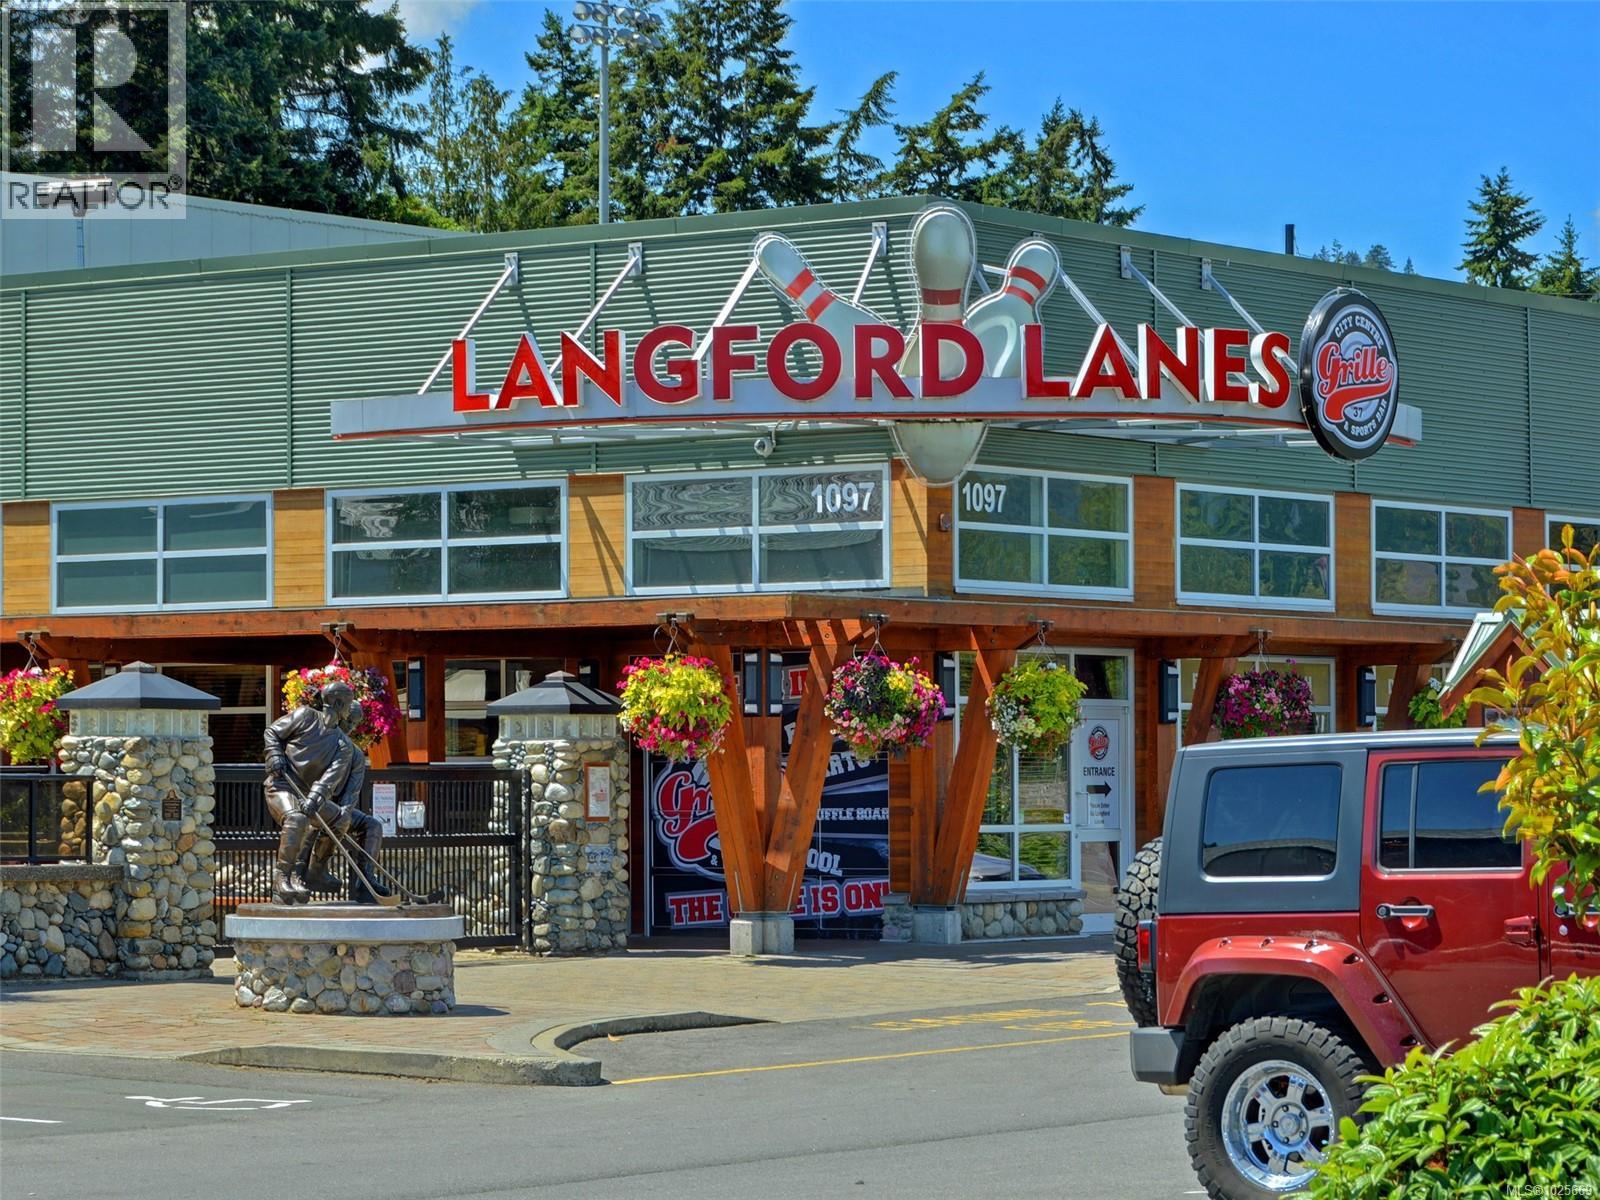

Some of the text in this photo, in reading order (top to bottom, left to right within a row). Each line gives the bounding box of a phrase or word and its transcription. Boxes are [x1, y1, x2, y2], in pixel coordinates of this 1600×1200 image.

[1334, 315, 1384, 350] CITY CENTRE
[452, 322, 1292, 412] LANGFORD LANES
[1317, 341, 1389, 398] Grille
[1350, 421, 1377, 437] SPORTS
[1375, 398, 1388, 422] BAR
[1353, 407, 1363, 418] 37
[811, 482, 876, 513] 1097
[962, 482, 1007, 513] 1097
[1083, 766, 1116, 777] ENTRANCE
[667, 892, 723, 926] THE
[811, 883, 840, 915] IS
